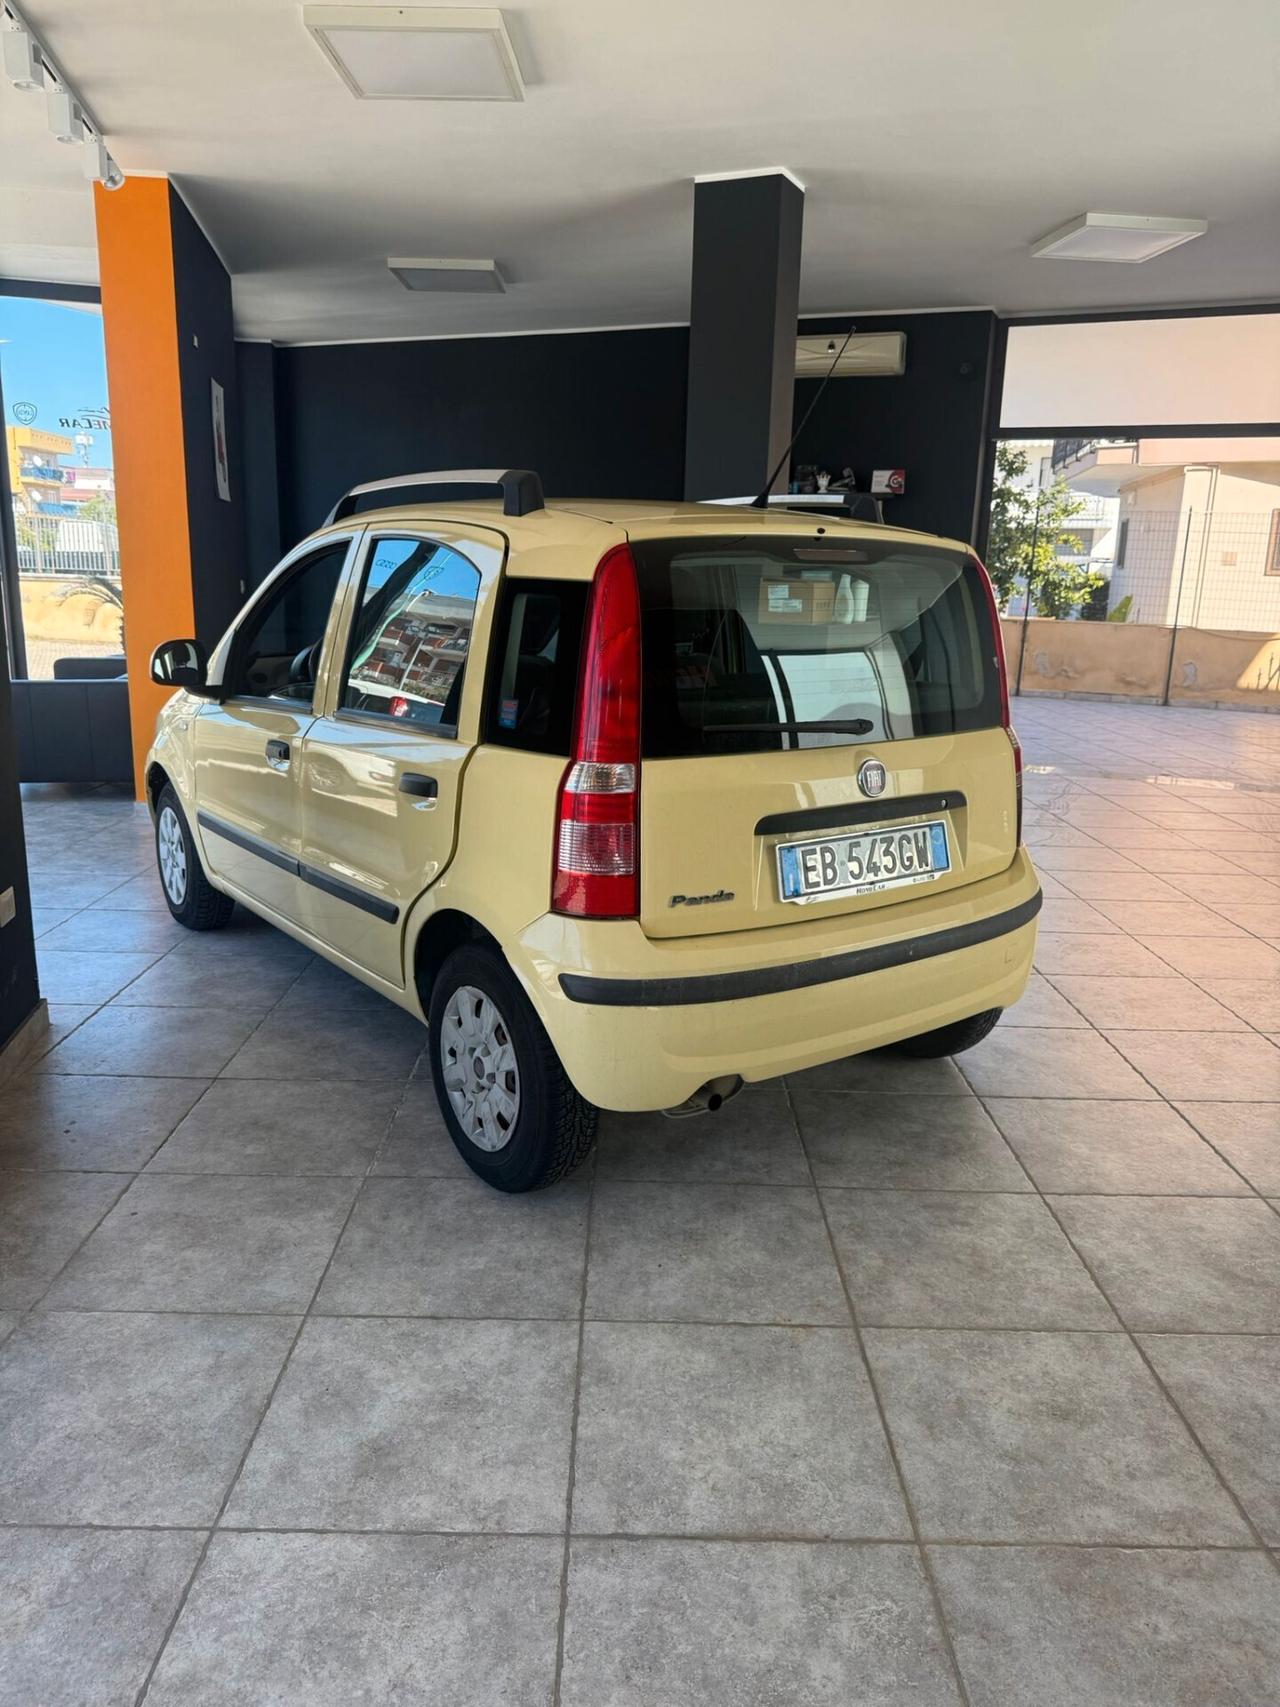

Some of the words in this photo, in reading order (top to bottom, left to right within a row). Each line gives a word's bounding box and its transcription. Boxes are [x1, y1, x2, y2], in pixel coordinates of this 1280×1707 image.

[801, 845, 839, 890] EB
[847, 830, 930, 881] 543GW
[668, 889, 735, 908] Panda
